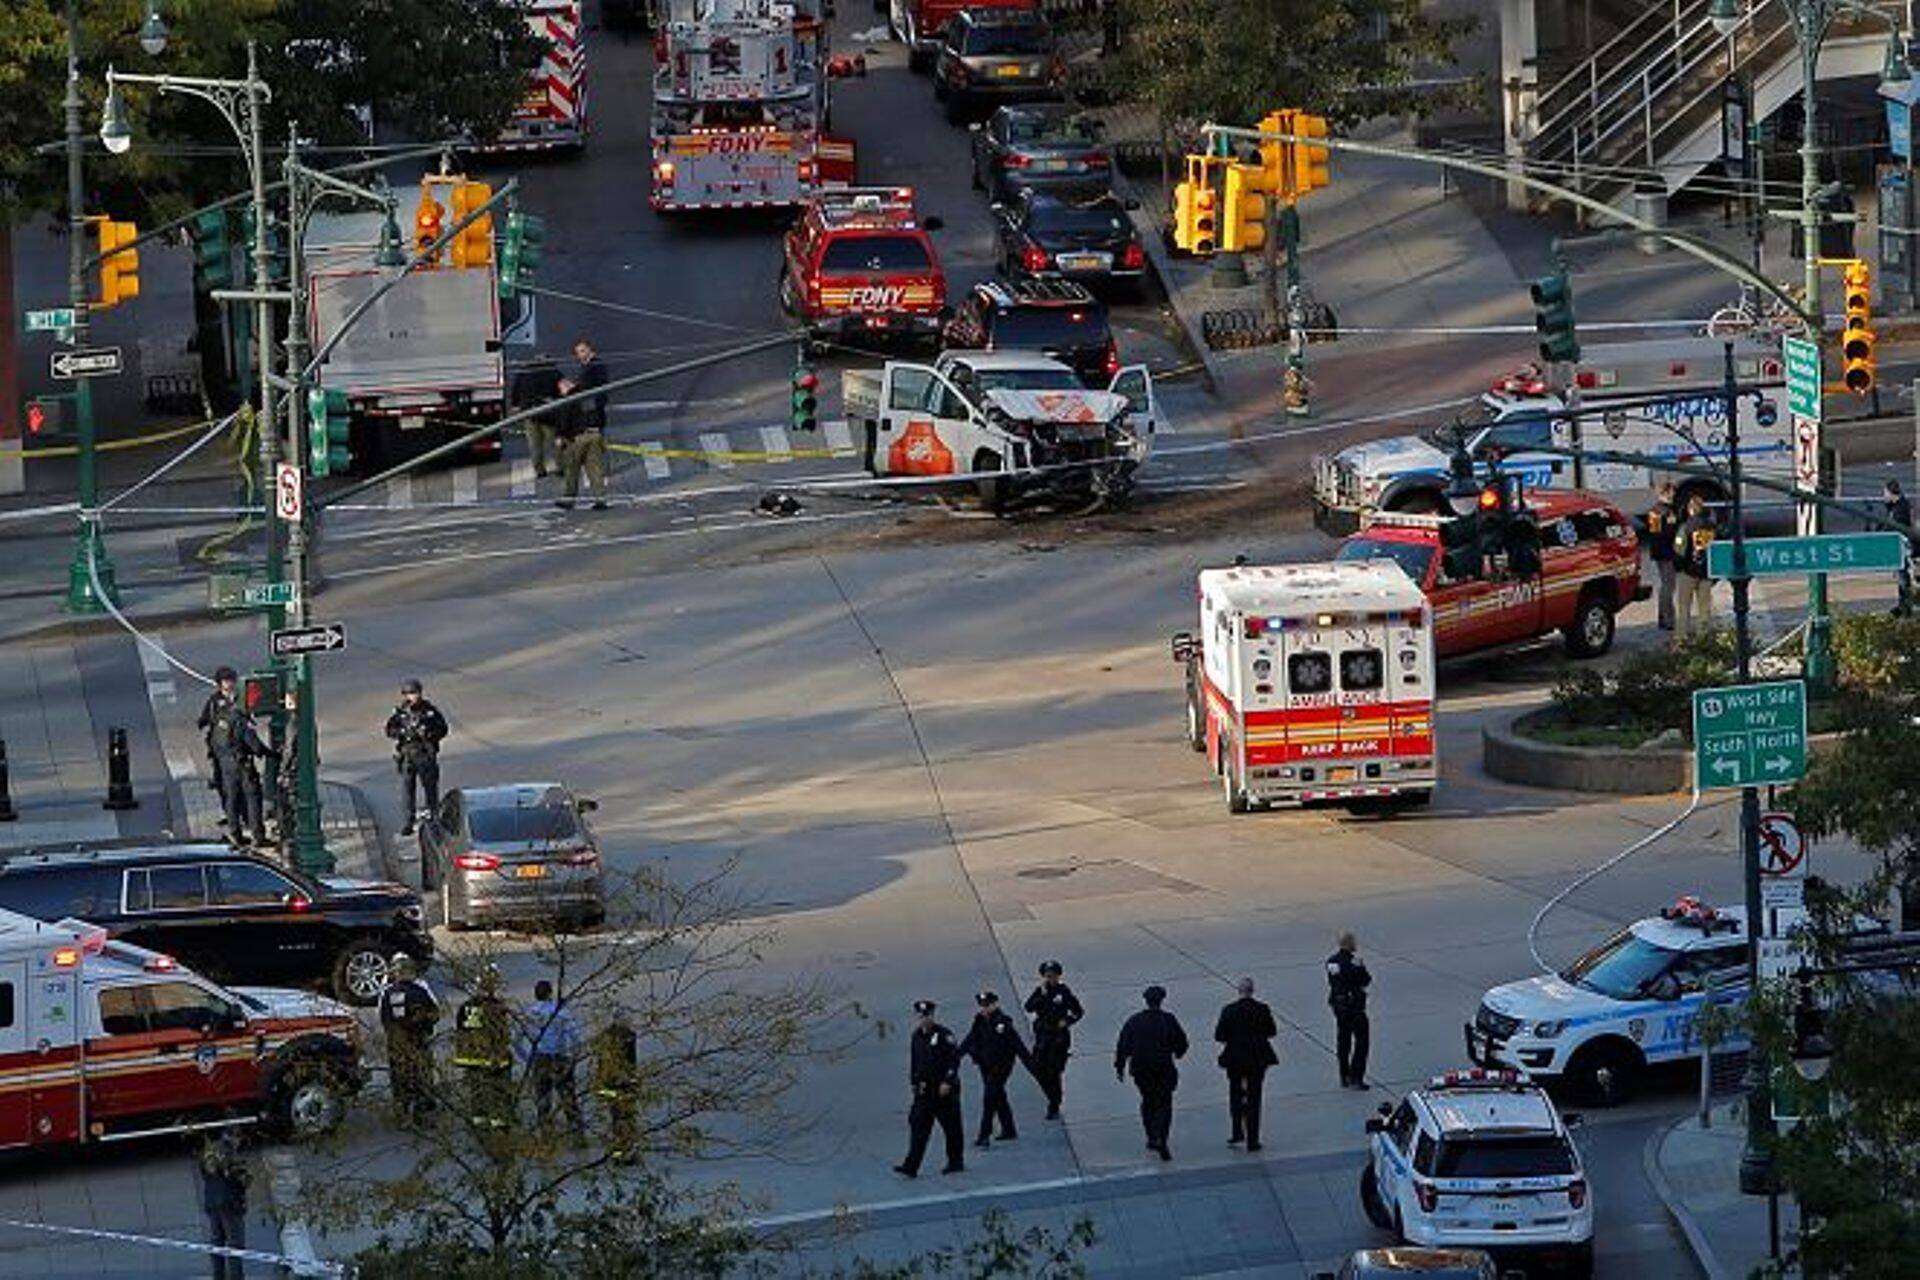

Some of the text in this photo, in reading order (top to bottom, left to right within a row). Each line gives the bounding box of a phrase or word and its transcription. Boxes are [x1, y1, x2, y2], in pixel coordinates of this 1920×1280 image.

[708, 136, 764, 153] FDNY
[849, 286, 905, 304] FDNY
[1756, 544, 1854, 566] West St
[1291, 692, 1383, 707] AMBULANCE
[1725, 688, 1797, 709] West Side
[1301, 740, 1379, 756] KEEP BACK
[1703, 736, 1747, 755] South
[1755, 732, 1800, 750] North
